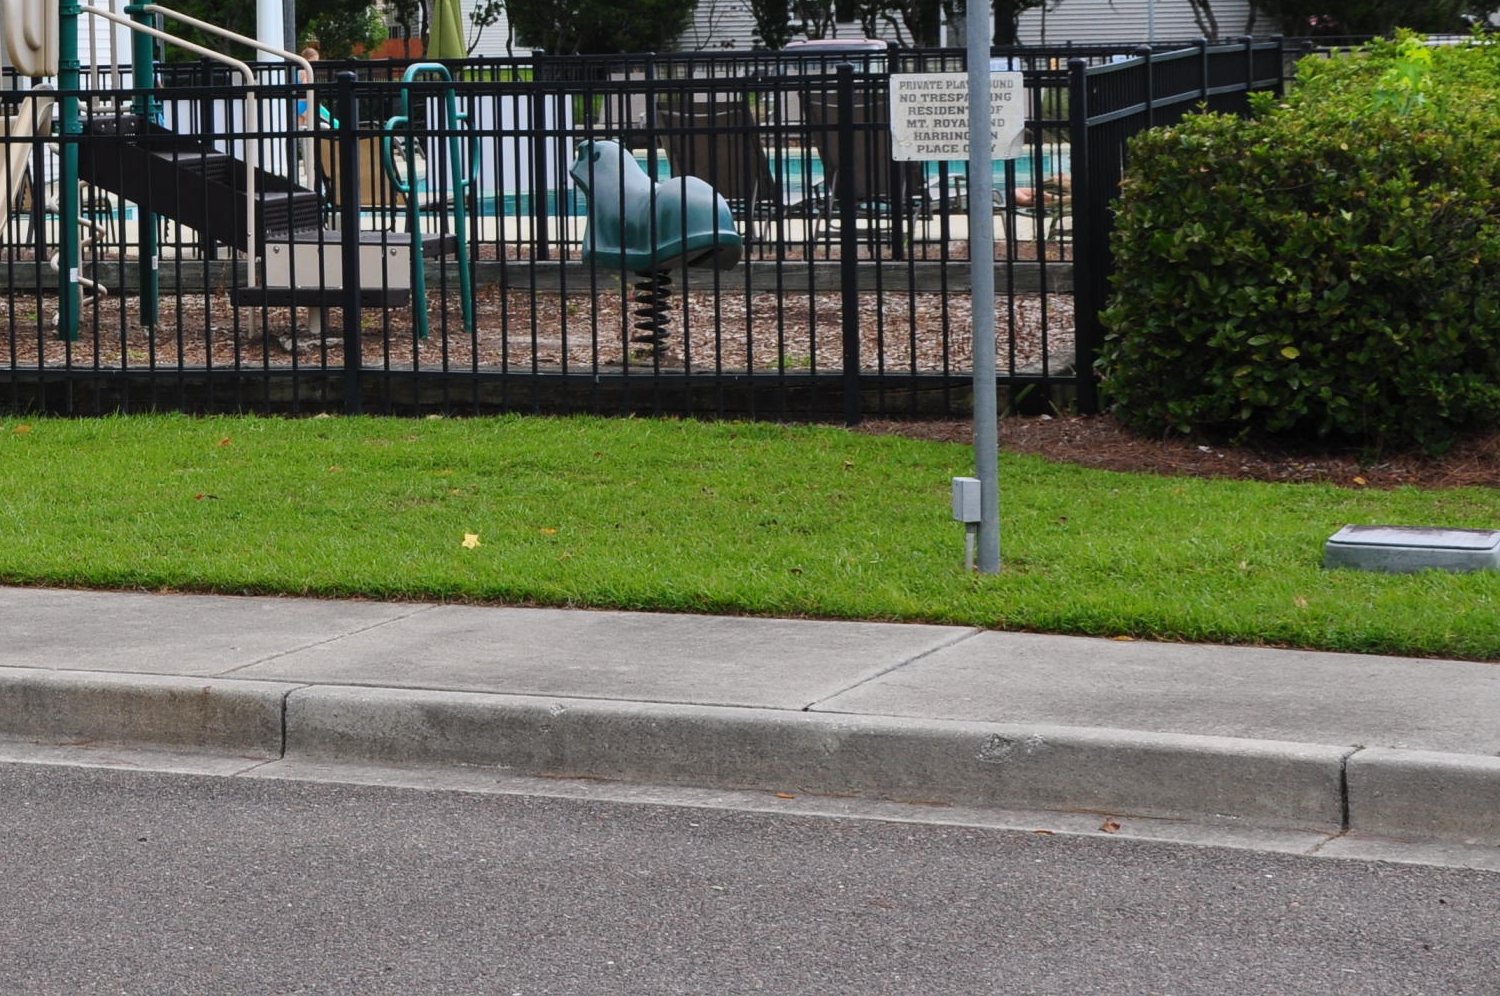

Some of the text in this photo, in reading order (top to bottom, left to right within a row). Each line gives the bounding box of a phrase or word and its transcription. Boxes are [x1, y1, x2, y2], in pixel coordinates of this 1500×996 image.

[899, 80, 943, 90] PRIVATE
[900, 93, 917, 103] NO
[906, 119, 929, 129] MT.
[933, 118, 969, 128] ROYA
[917, 144, 959, 154] PLACE
